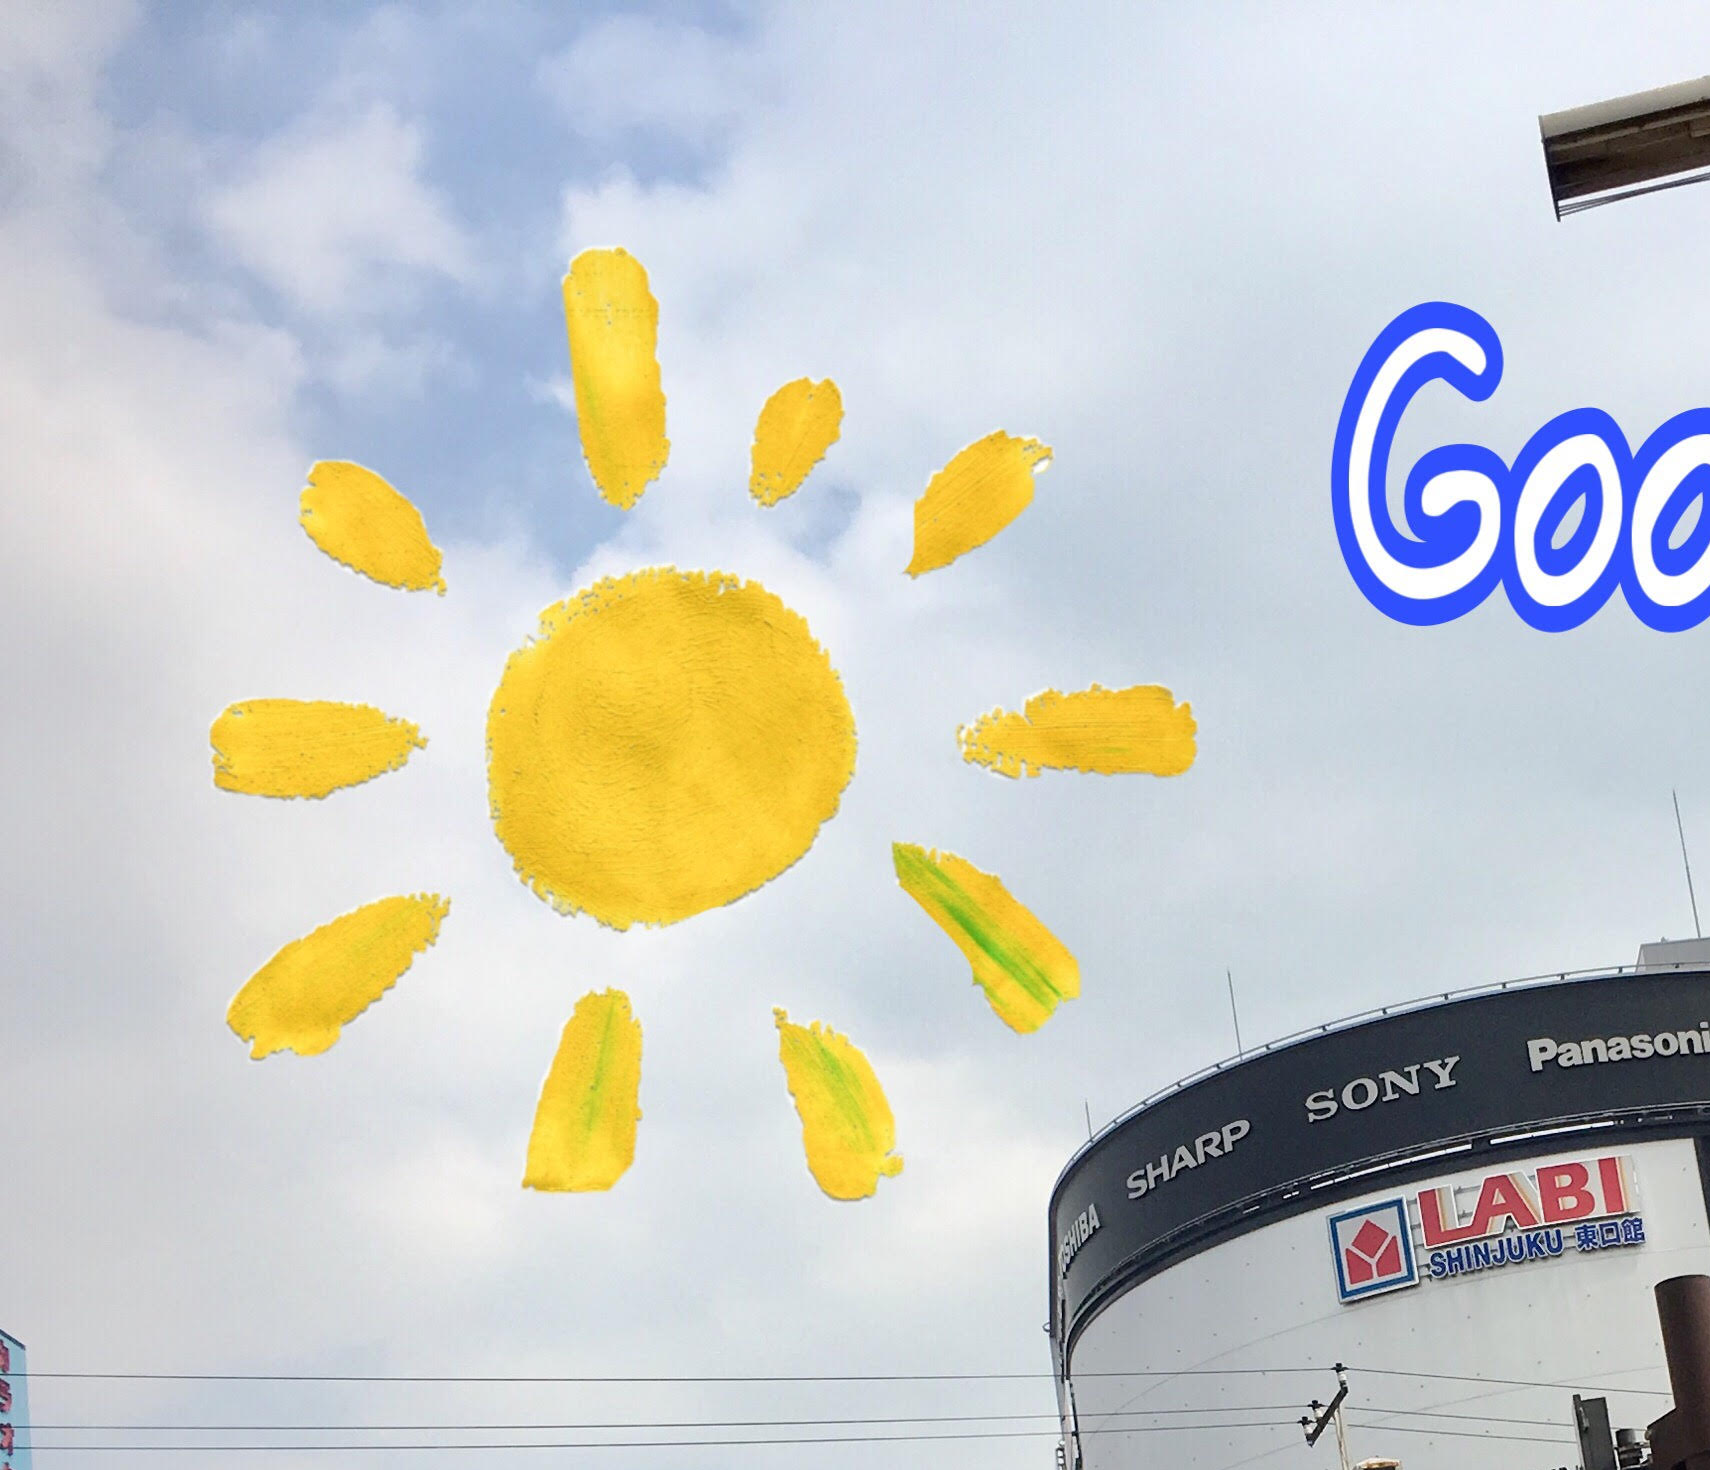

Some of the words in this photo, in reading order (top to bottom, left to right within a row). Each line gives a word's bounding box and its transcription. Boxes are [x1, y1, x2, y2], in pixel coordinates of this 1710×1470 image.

[1305, 1056, 1461, 1123] SONY
[1126, 1119, 1251, 1200] SHARP
[1418, 1156, 1627, 1249] LABI
[1058, 1203, 1101, 1275] OSHIBA
[1429, 1230, 1564, 1279] SHINJUKU
[1576, 1216, 1646, 1252] 東口館
